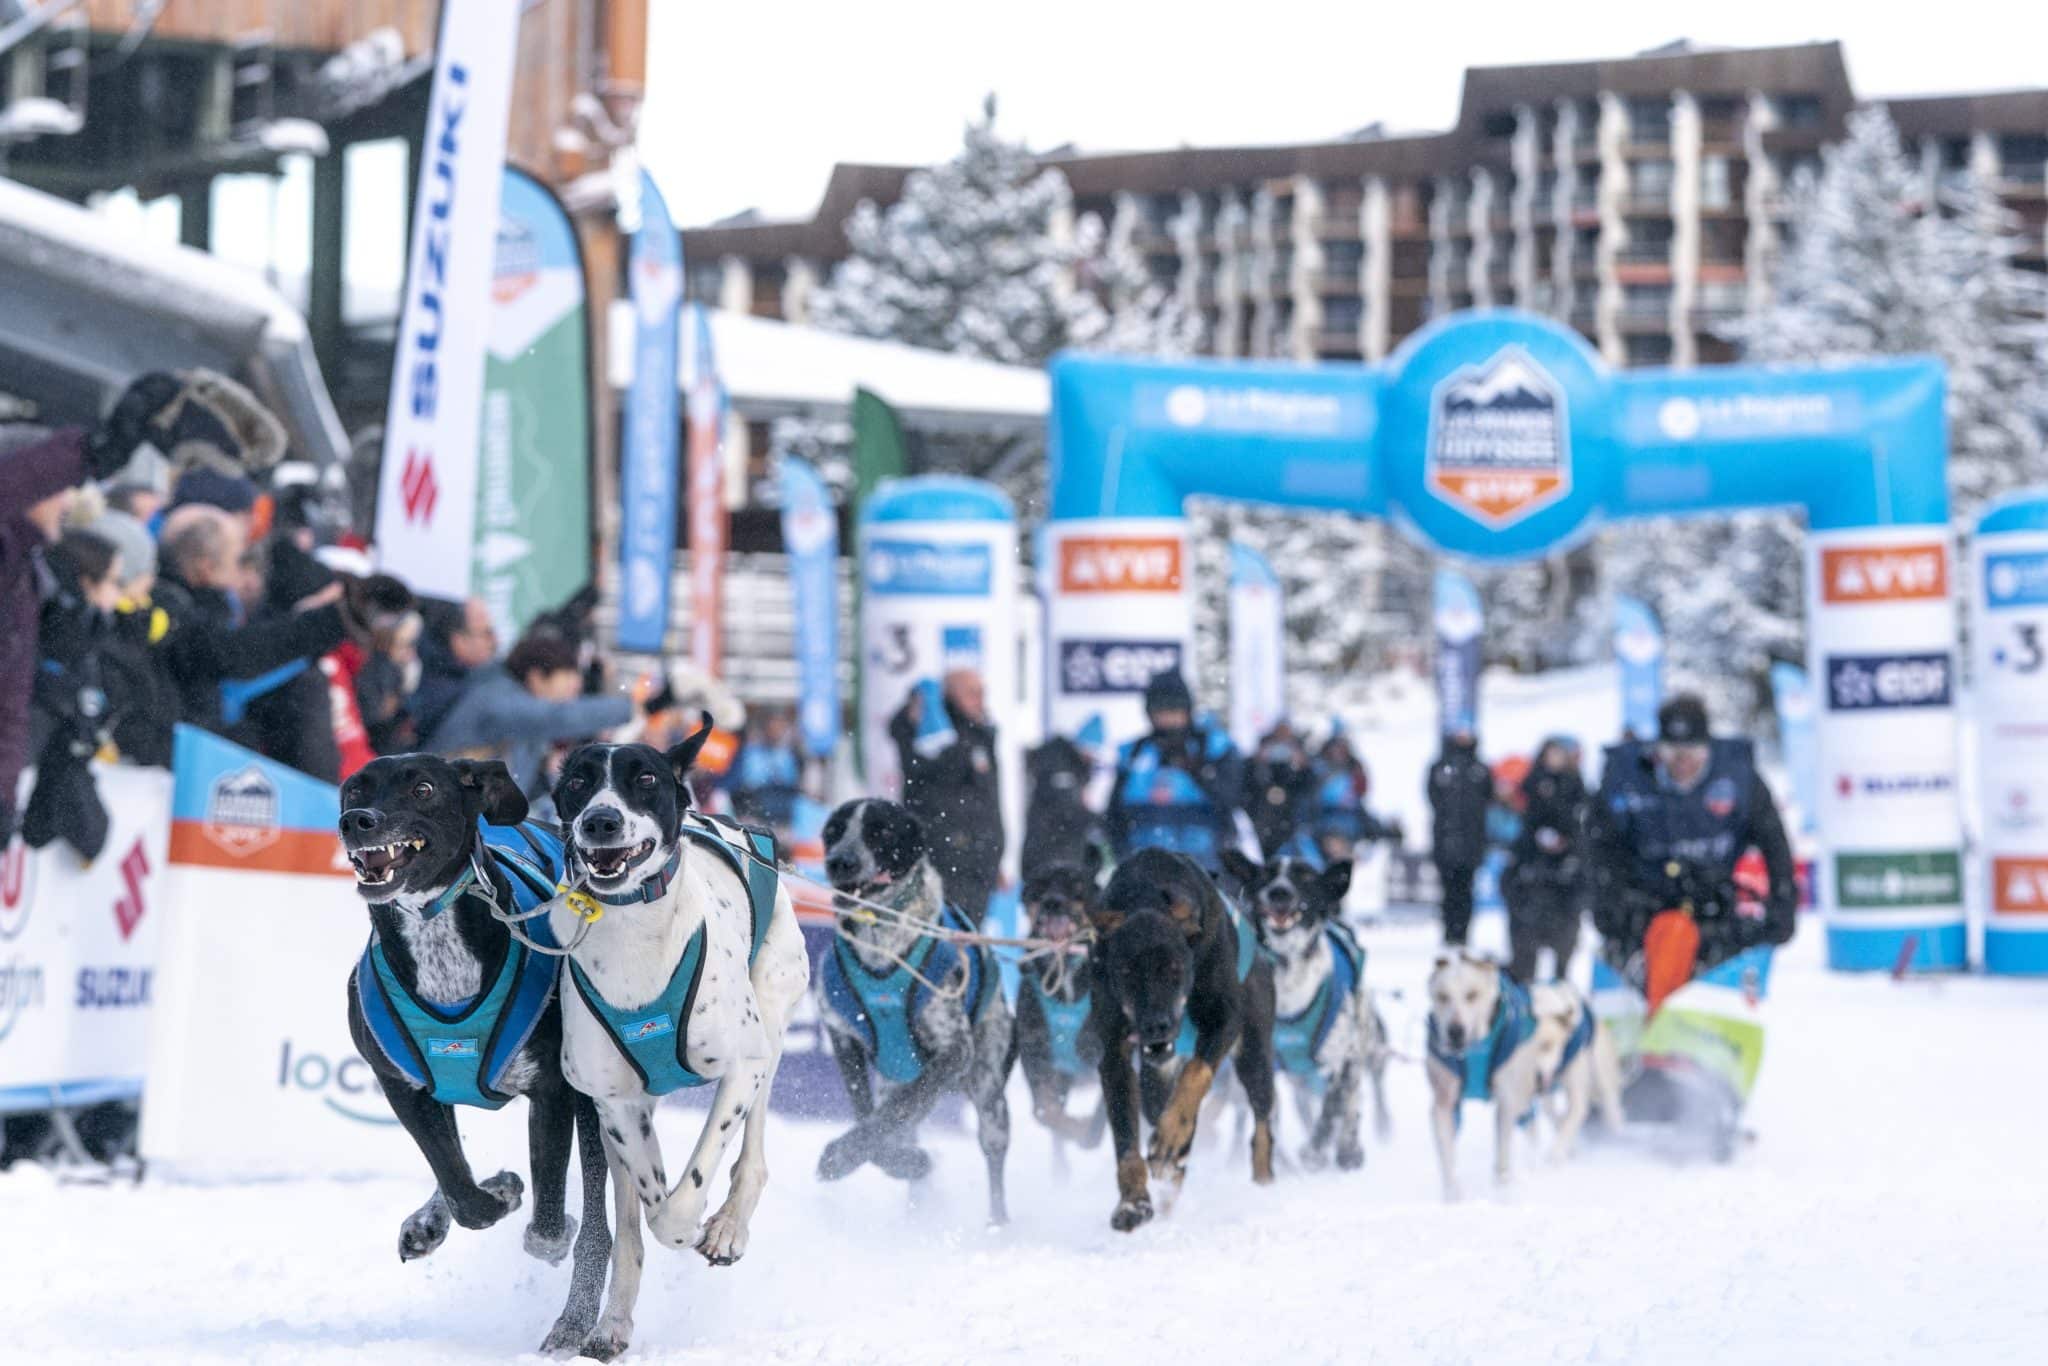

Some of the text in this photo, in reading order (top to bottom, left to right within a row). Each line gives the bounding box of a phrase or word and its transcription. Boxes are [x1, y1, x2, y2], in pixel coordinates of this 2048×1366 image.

[409, 63, 468, 420] SUZUKI
[2012, 622, 2044, 673] 3
[279, 1038, 386, 1094] loc
